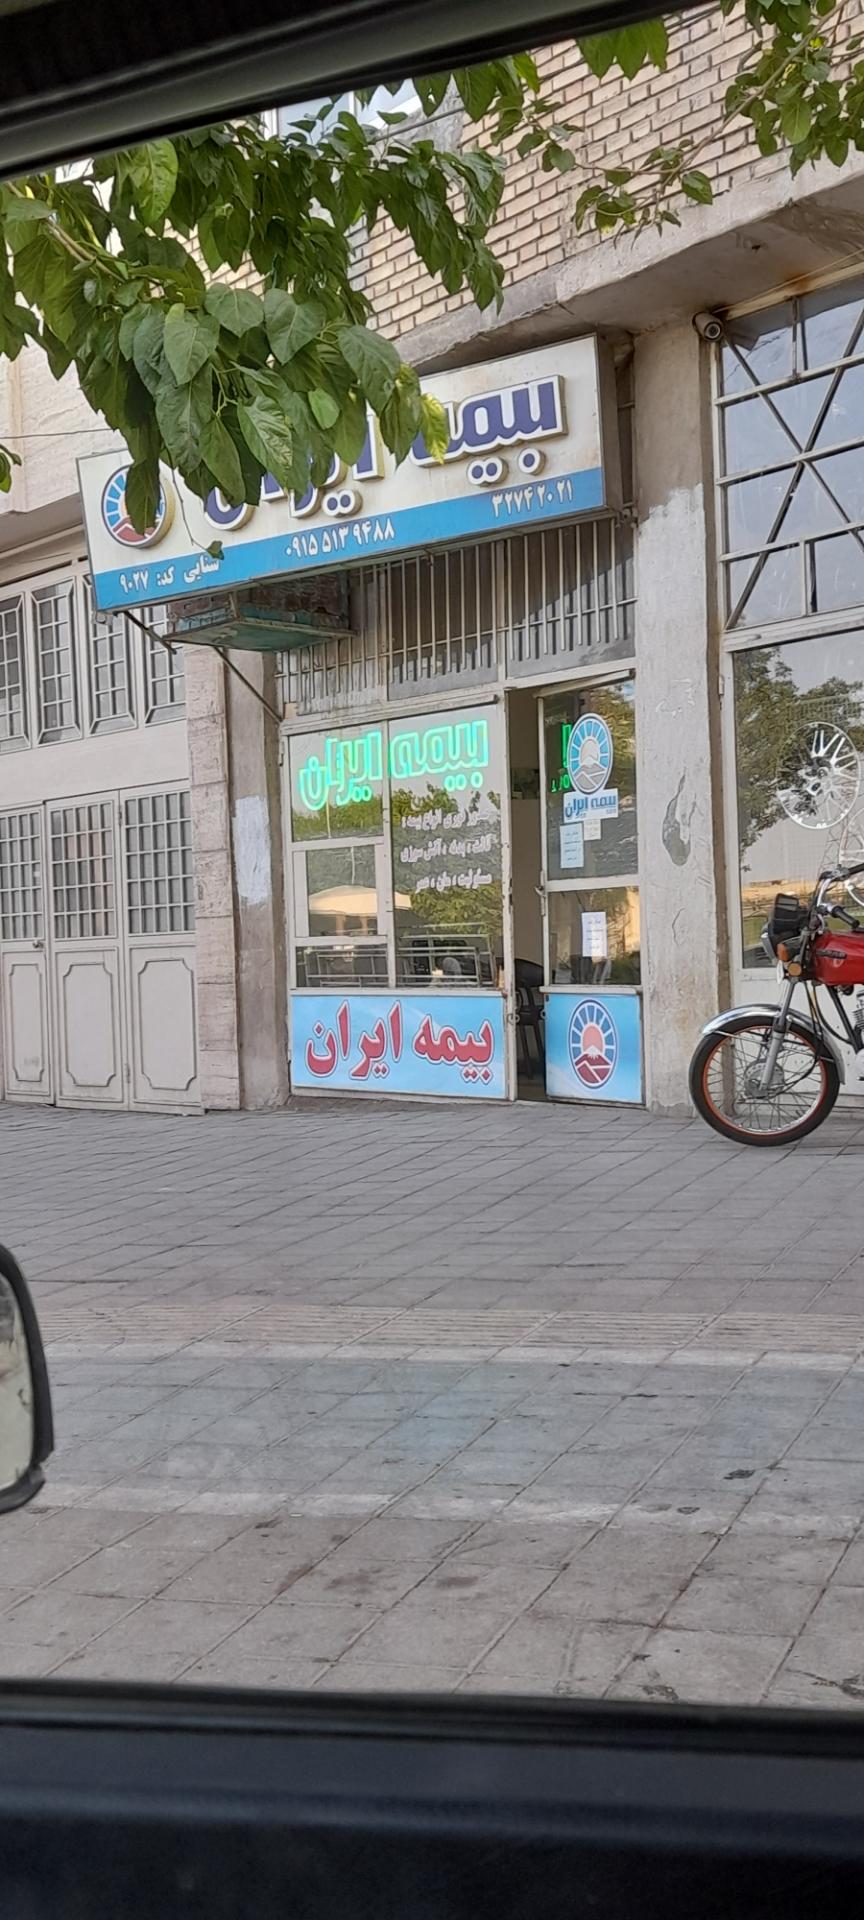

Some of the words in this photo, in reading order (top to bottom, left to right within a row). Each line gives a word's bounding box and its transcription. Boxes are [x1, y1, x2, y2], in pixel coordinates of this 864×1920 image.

[120, 569, 149, 593] ۹۰۲۷
[298, 730, 383, 811] ایران
[390, 719, 489, 793] بیمه
[564, 796, 588, 819] ایران
[591, 795, 617, 815] بیمه
[305, 998, 403, 1081] ایران
[412, 1013, 495, 1085] بیمه
